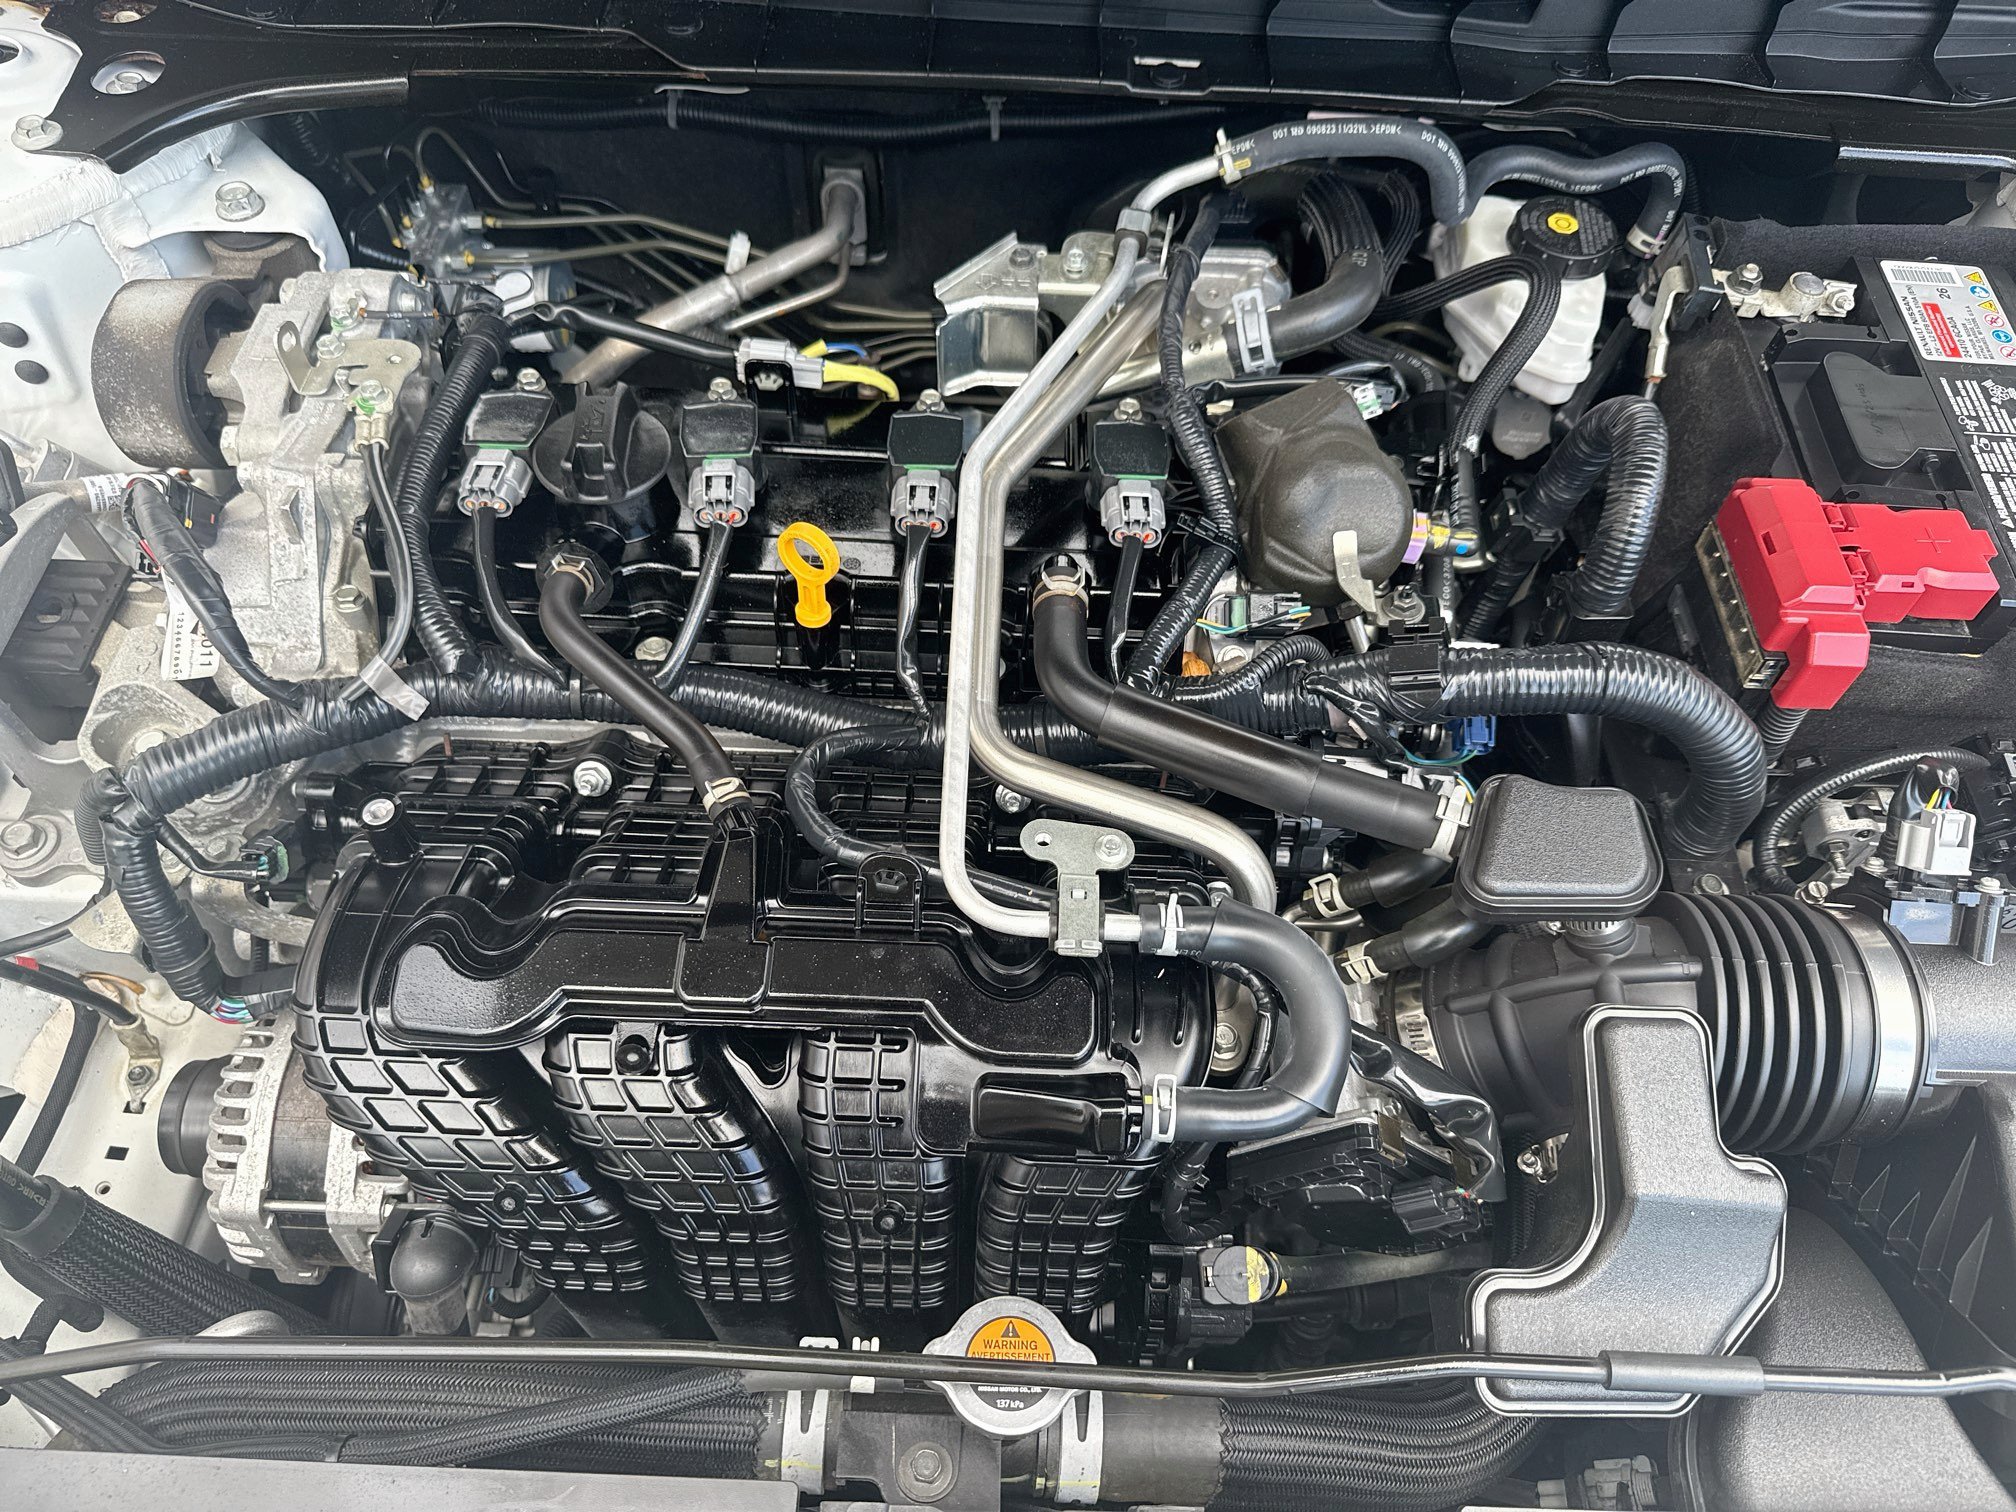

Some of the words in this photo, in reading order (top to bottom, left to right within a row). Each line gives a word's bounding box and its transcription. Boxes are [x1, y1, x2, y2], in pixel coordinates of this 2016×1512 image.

[1936, 288, 1950, 299] 26
[1901, 296, 1919, 324] NISSAN
[1914, 326, 1933, 355] RENAULT
[983, 1339, 1038, 1351] WARNING
[971, 1351, 1050, 1362] AVERTISSEMENT
[978, 1385, 998, 1393] NISSAN
[996, 1399, 1010, 1408] 137
[1010, 1399, 1024, 1409] kPa
